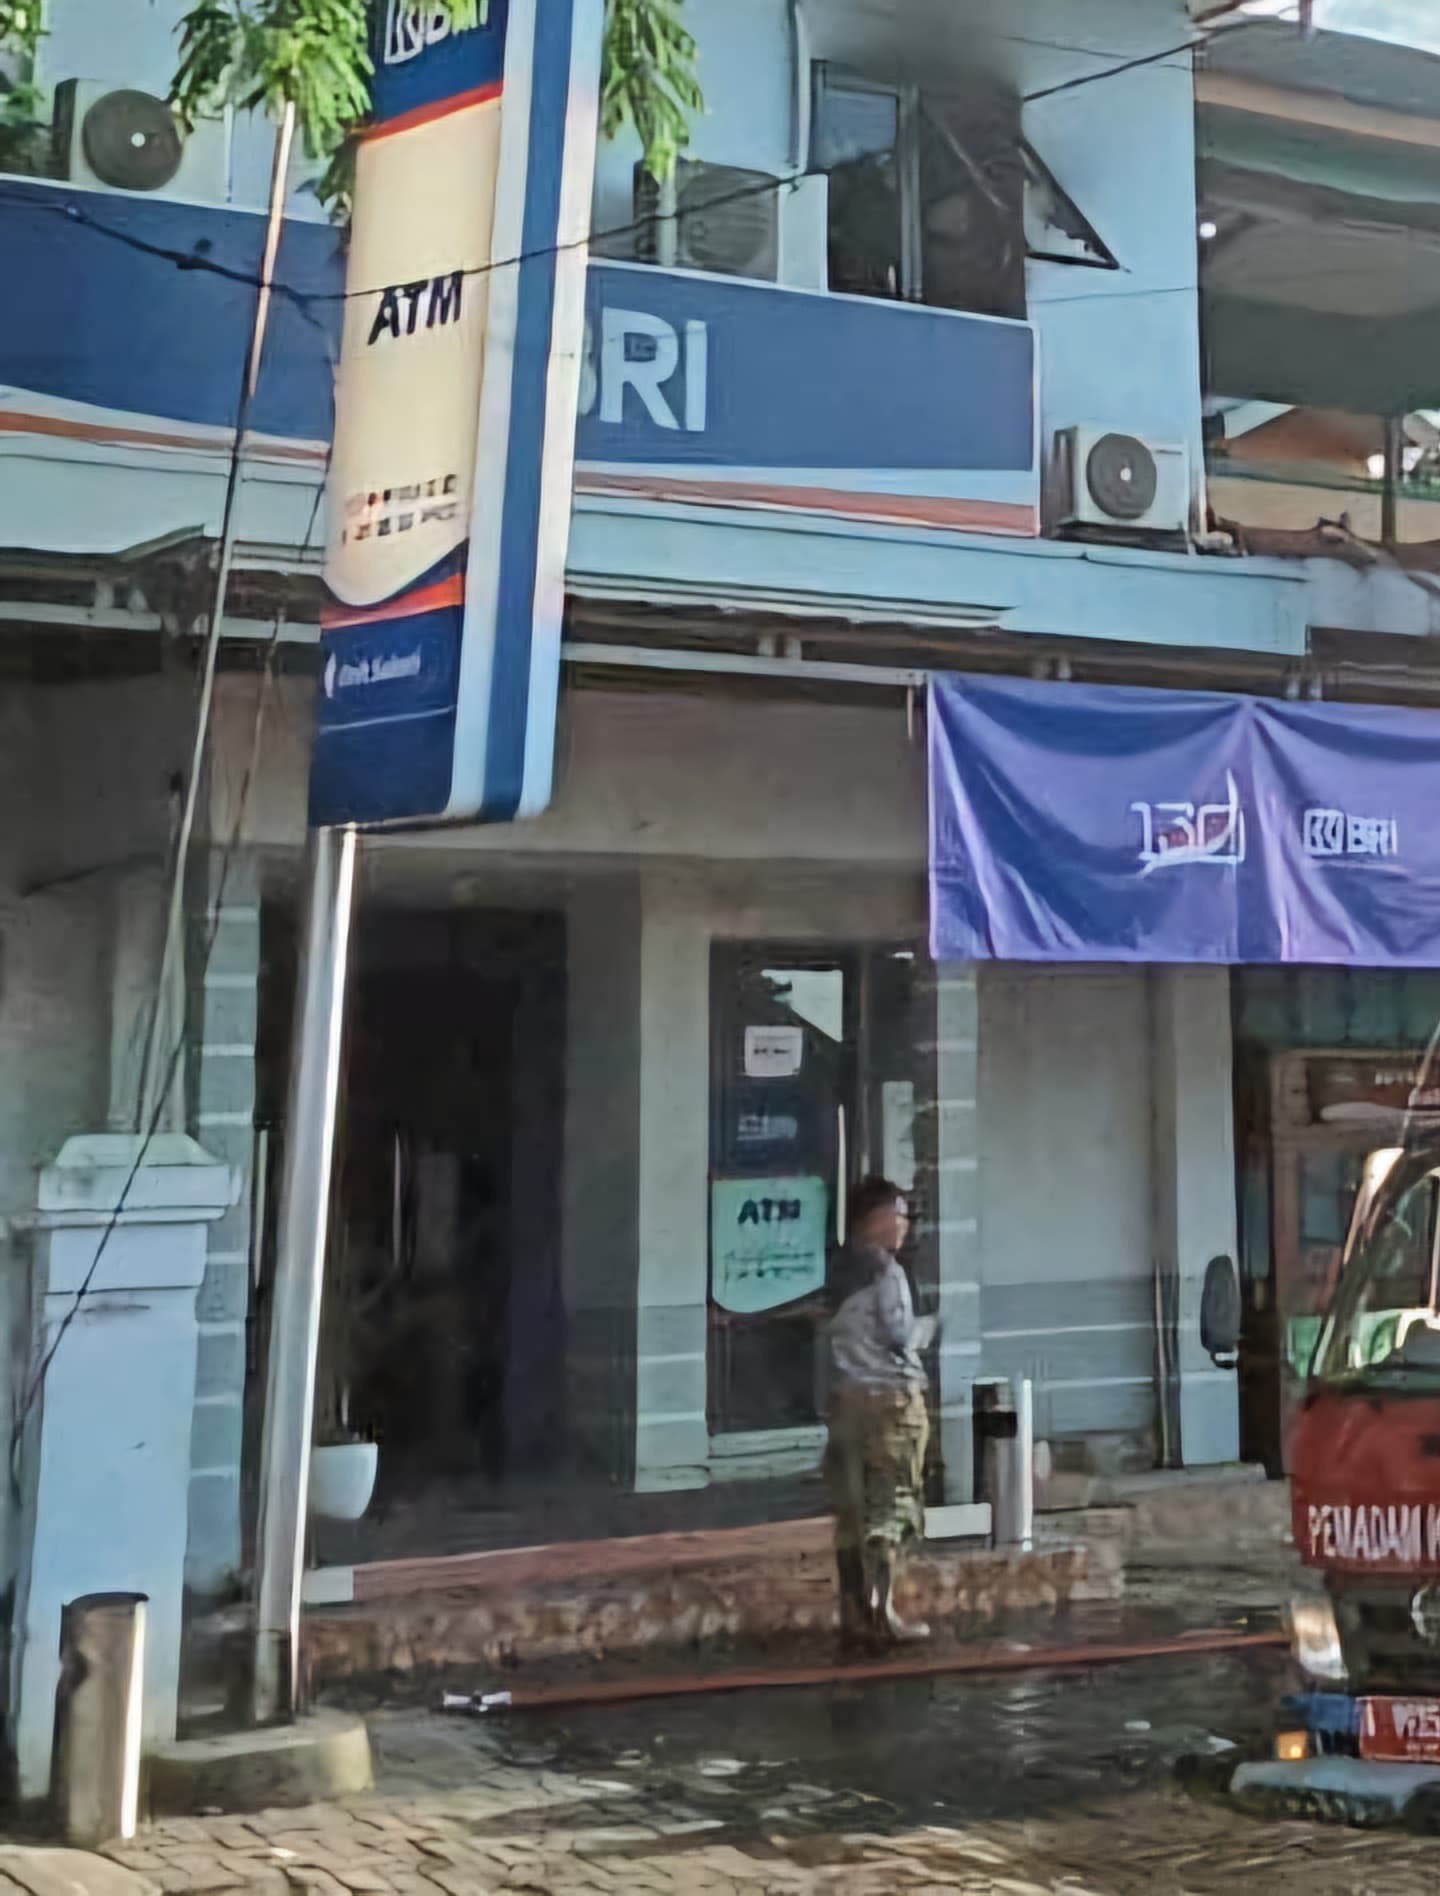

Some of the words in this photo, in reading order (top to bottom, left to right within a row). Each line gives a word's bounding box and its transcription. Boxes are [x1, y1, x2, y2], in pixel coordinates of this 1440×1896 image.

[368, 270, 464, 345] ATM
[578, 306, 707, 432] RI
[1347, 812, 1397, 855] BRI
